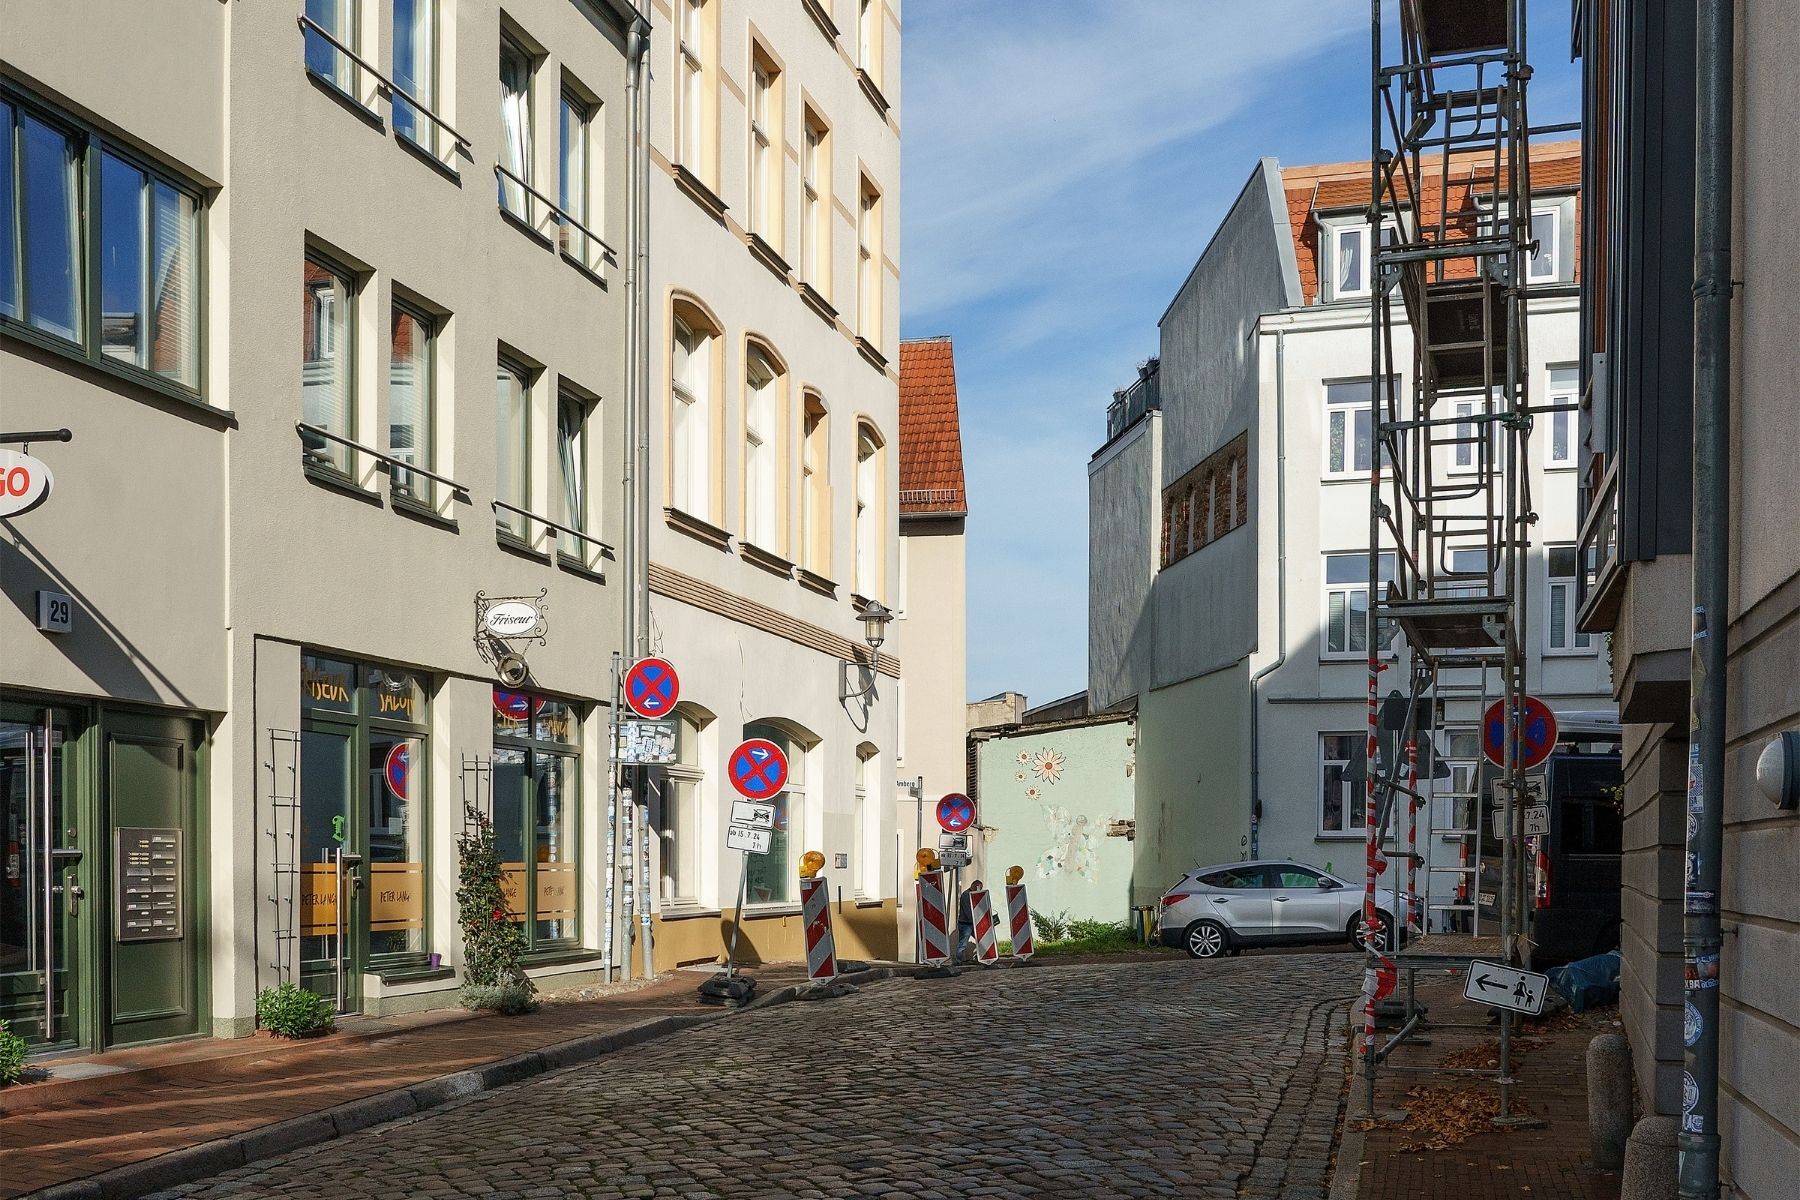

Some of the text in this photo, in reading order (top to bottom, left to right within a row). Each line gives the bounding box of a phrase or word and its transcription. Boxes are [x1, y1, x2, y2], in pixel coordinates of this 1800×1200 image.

[0, 467, 30, 496] O
[50, 600, 68, 624] 29
[490, 613, 533, 626] Friseur
[301, 892, 337, 906] PETER LANG
[380, 890, 395, 903] PETER
